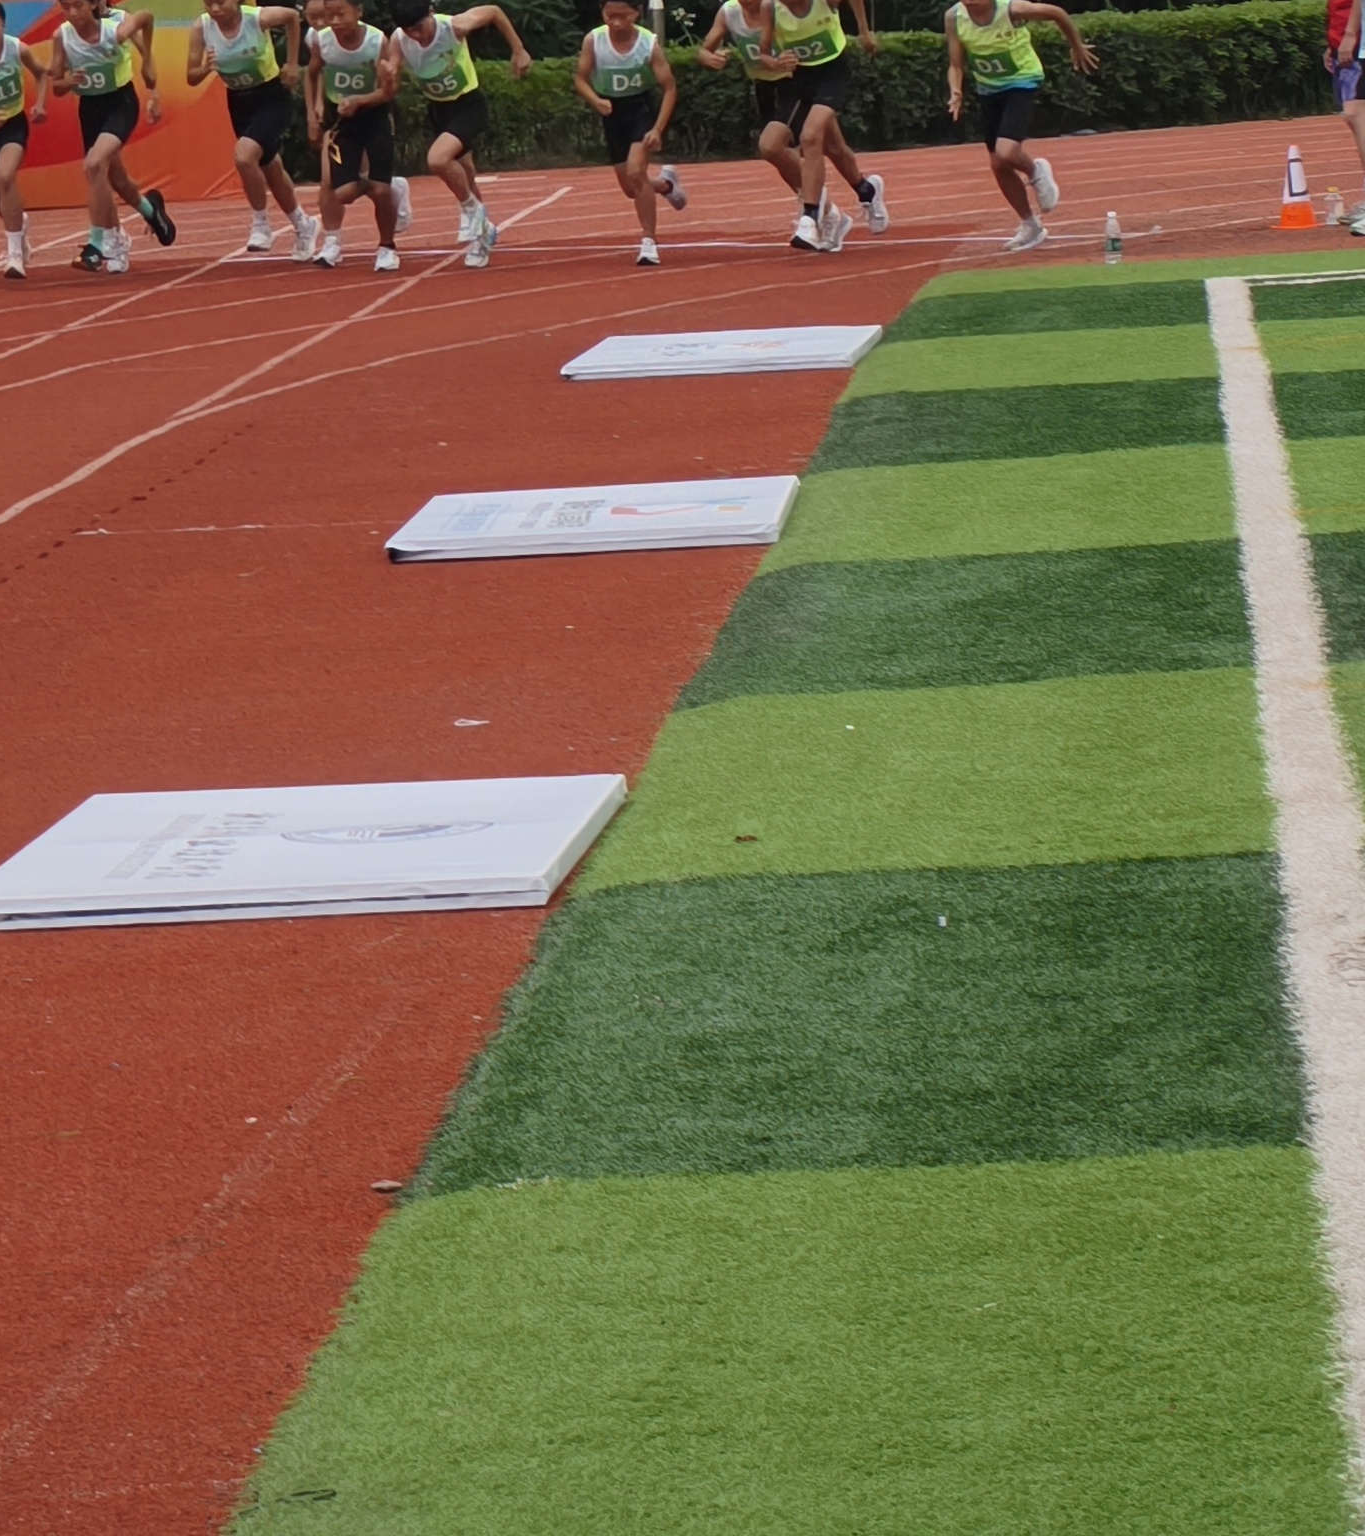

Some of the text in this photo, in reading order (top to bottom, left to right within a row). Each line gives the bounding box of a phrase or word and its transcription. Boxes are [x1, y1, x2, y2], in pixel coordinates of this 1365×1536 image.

[793, 41, 826, 58] D2
[334, 72, 365, 89] D6
[426, 74, 458, 94] D5
[612, 73, 643, 91] D4
